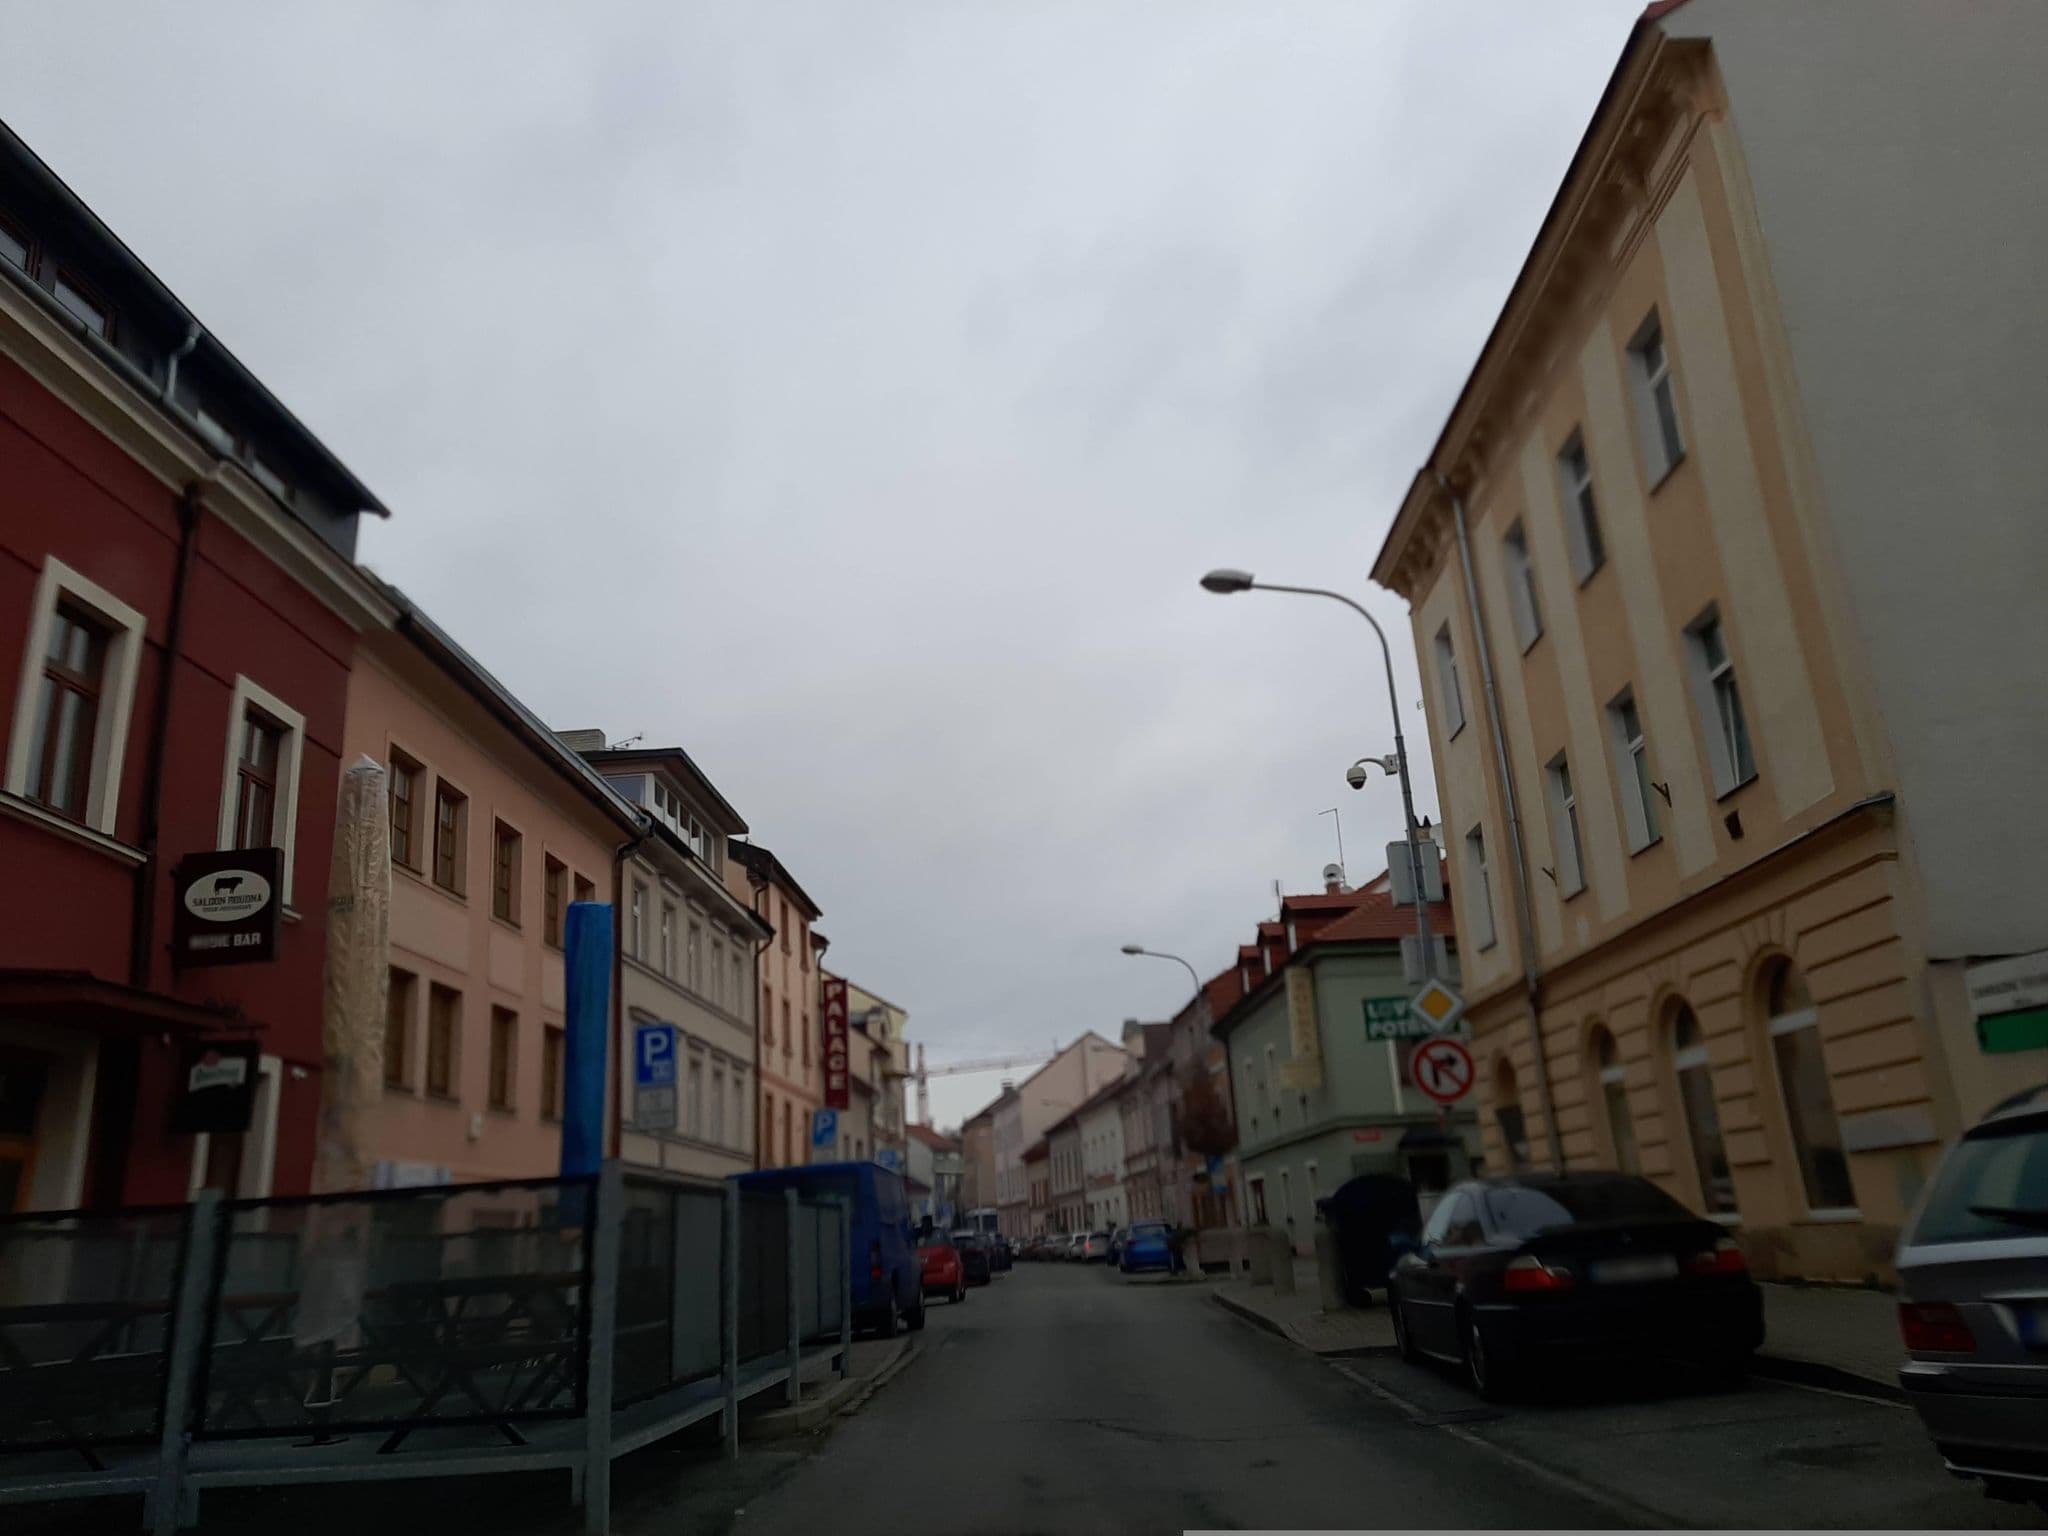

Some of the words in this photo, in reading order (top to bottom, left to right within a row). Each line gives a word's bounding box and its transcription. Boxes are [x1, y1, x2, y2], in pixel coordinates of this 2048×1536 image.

[233, 932, 262, 947] BAR
[644, 1031, 670, 1067] P
[826, 982, 846, 1090] PALACE
